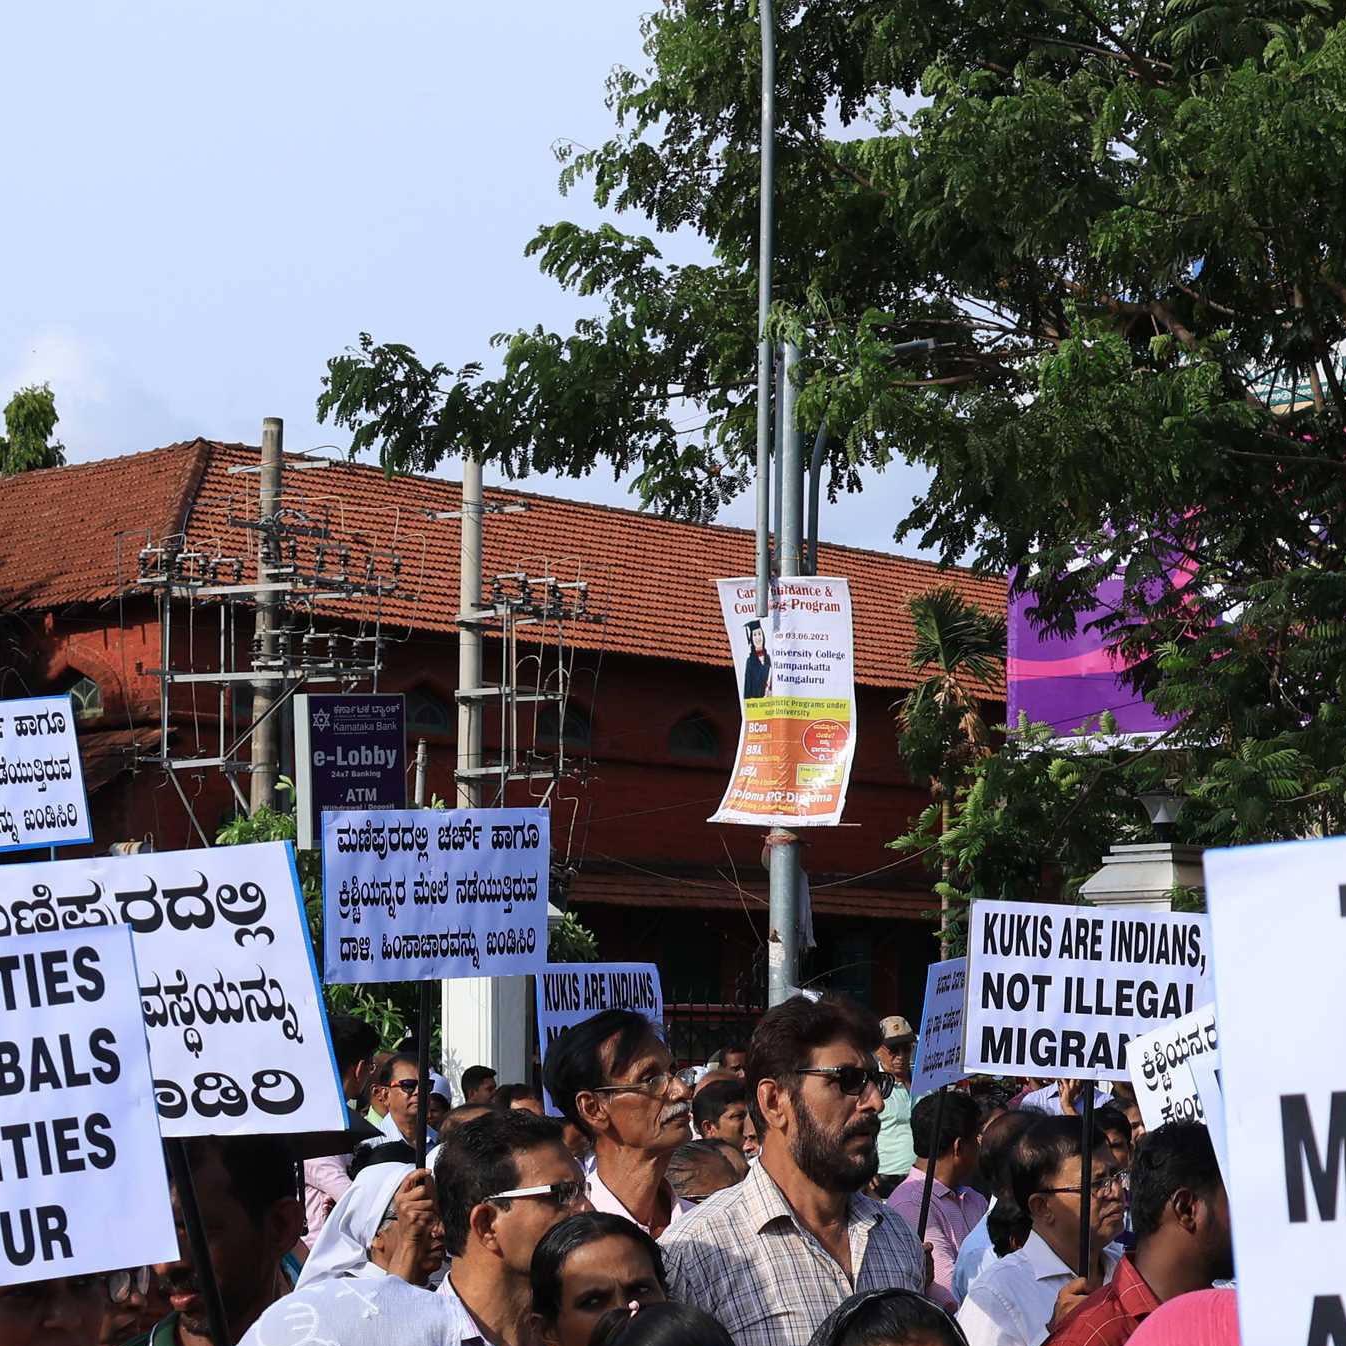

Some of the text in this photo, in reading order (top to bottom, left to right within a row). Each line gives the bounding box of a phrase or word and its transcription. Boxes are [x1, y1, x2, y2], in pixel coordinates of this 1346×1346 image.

[791, 598, 840, 613] Program
[815, 649, 845, 660] College
[777, 674, 824, 685] Mangaluru
[826, 701, 846, 709] under
[14, 708, 66, 737] ಹಾಗೂ
[333, 721, 397, 731] Karnataka Bank
[313, 745, 397, 768] e-Lobby
[351, 770, 381, 778] Banking
[346, 788, 377, 802] ATM
[491, 817, 539, 849] ಹಾಗೂ
[414, 871, 449, 905] ಮೇಲೆ
[983, 912, 1206, 976] KUKIS ARE INDIANS,
[543, 972, 658, 1016] KUKIS ARE INDIANS,
[982, 971, 1052, 1013] NOT
[141, 964, 304, 1059] ವಸ್ಥೆಯನ್ನು
[980, 1026, 1142, 1071] MIGRAN
